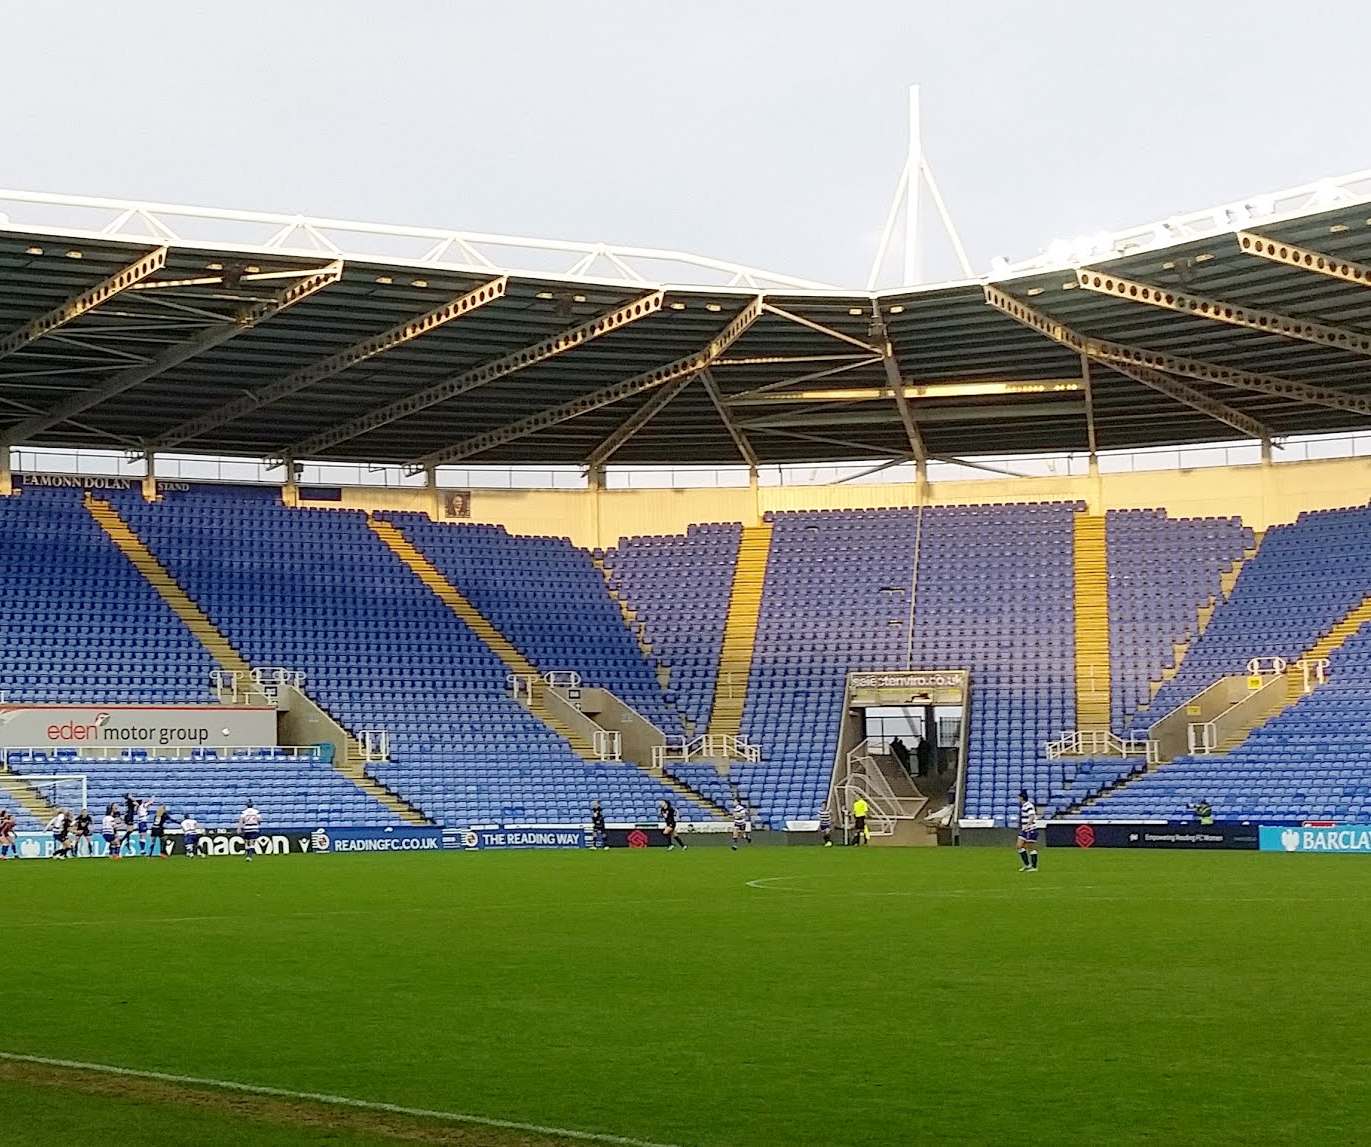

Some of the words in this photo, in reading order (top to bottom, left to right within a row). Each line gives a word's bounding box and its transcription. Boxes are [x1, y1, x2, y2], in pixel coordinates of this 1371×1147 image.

[22, 475, 80, 487] EAMONN
[84, 476, 131, 490] DOLAN
[157, 482, 190, 491] STAND
[47, 721, 98, 741] eden
[104, 725, 156, 741] motor
[159, 725, 209, 744] group
[334, 838, 438, 851] READINGFC.CO.UK
[482, 834, 505, 845] THE
[506, 833, 556, 845] READING
[557, 833, 580, 845] WAY
[1303, 831, 1371, 850] BARCLA
